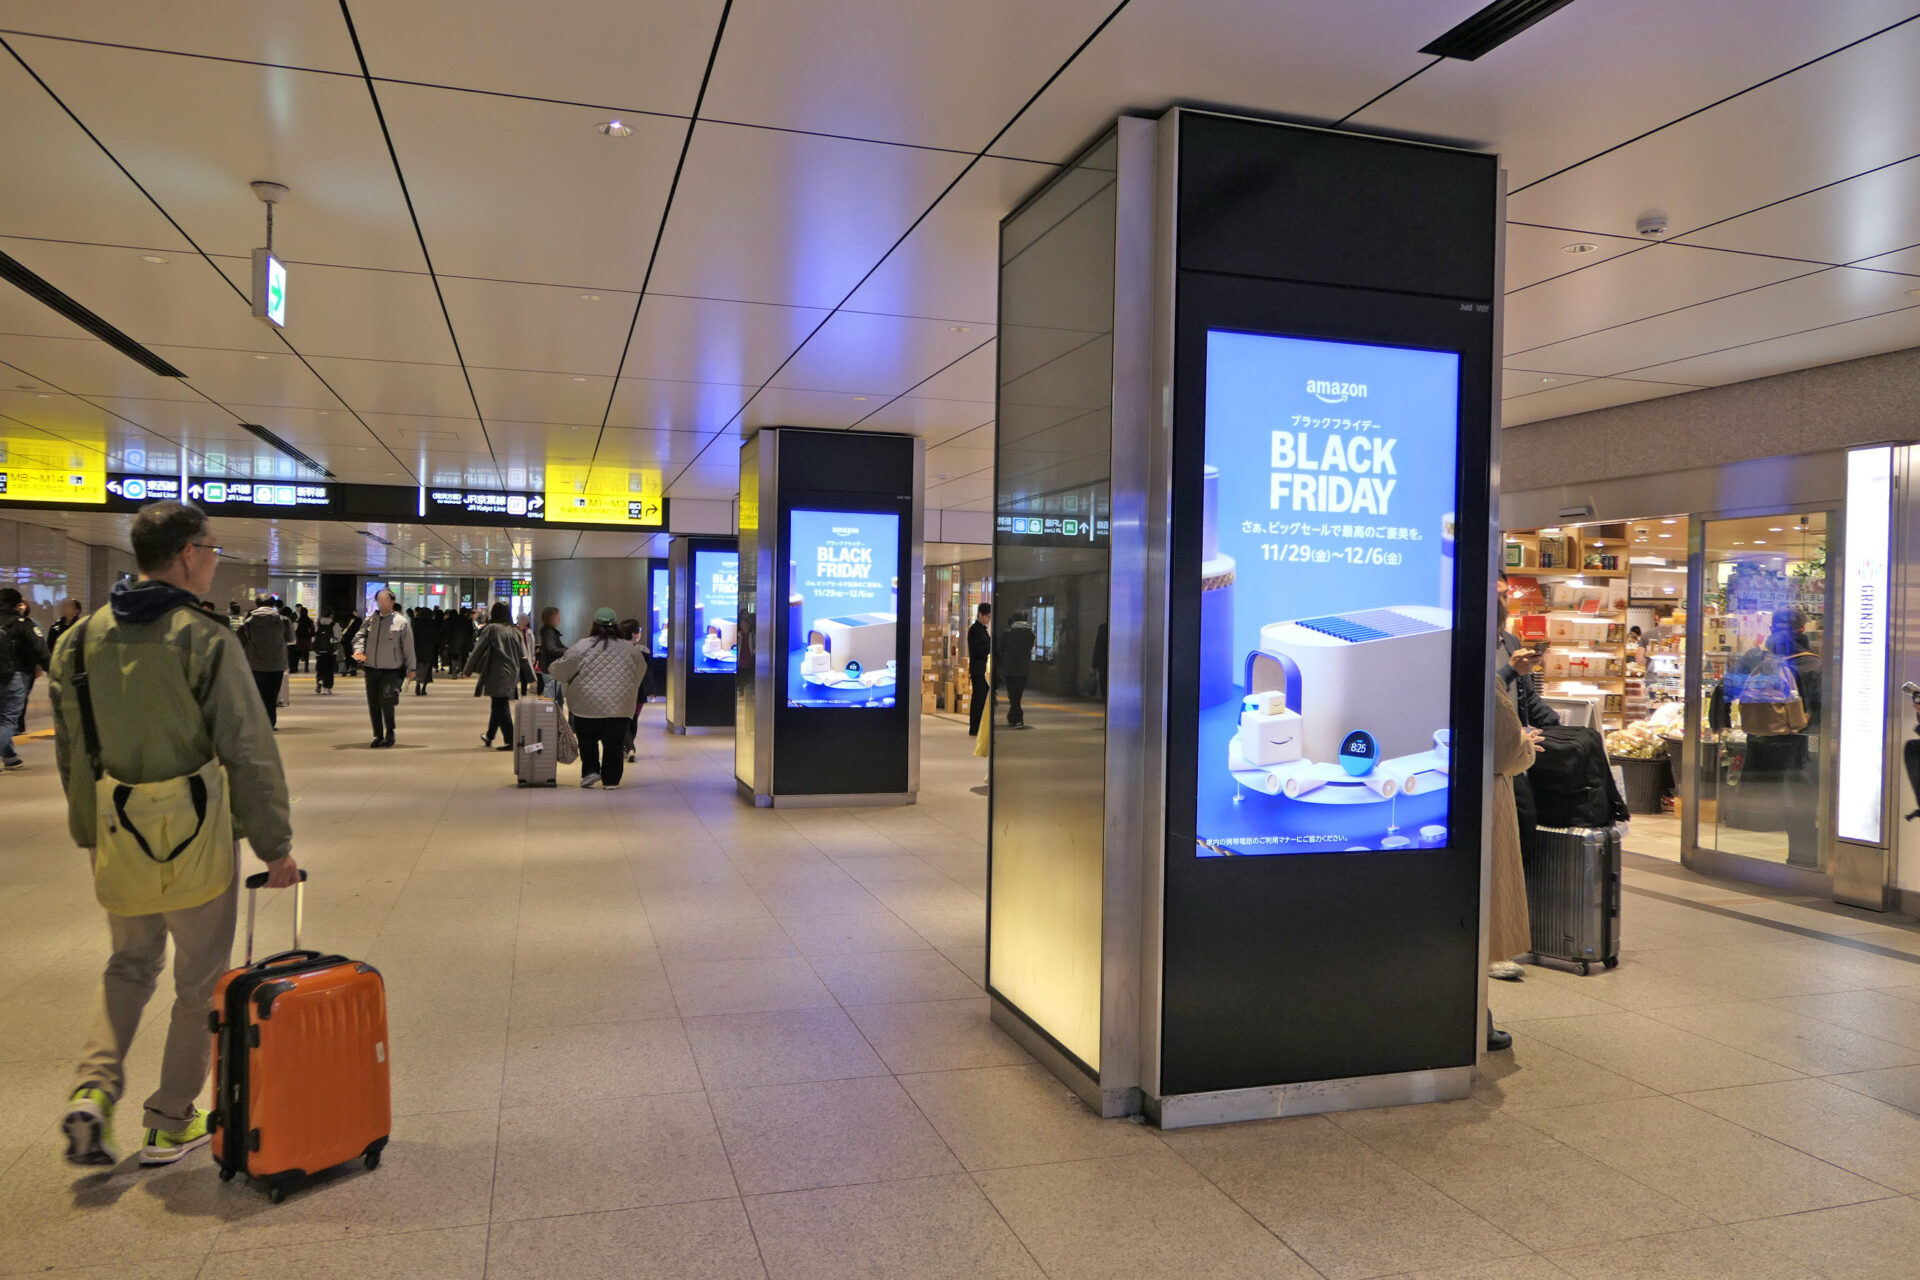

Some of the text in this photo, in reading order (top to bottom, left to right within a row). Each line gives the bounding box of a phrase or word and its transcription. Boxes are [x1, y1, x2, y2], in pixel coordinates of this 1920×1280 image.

[1306, 379, 1368, 398] amazon
[1291, 415, 1381, 432] ブラックフライデー
[1271, 430, 1398, 475] BLACK
[1270, 472, 1398, 515] FRIDAY
[817, 546, 873, 563] BLACK
[817, 562, 872, 579] FRIDAY
[1858, 585, 1874, 645] GRANSTA
